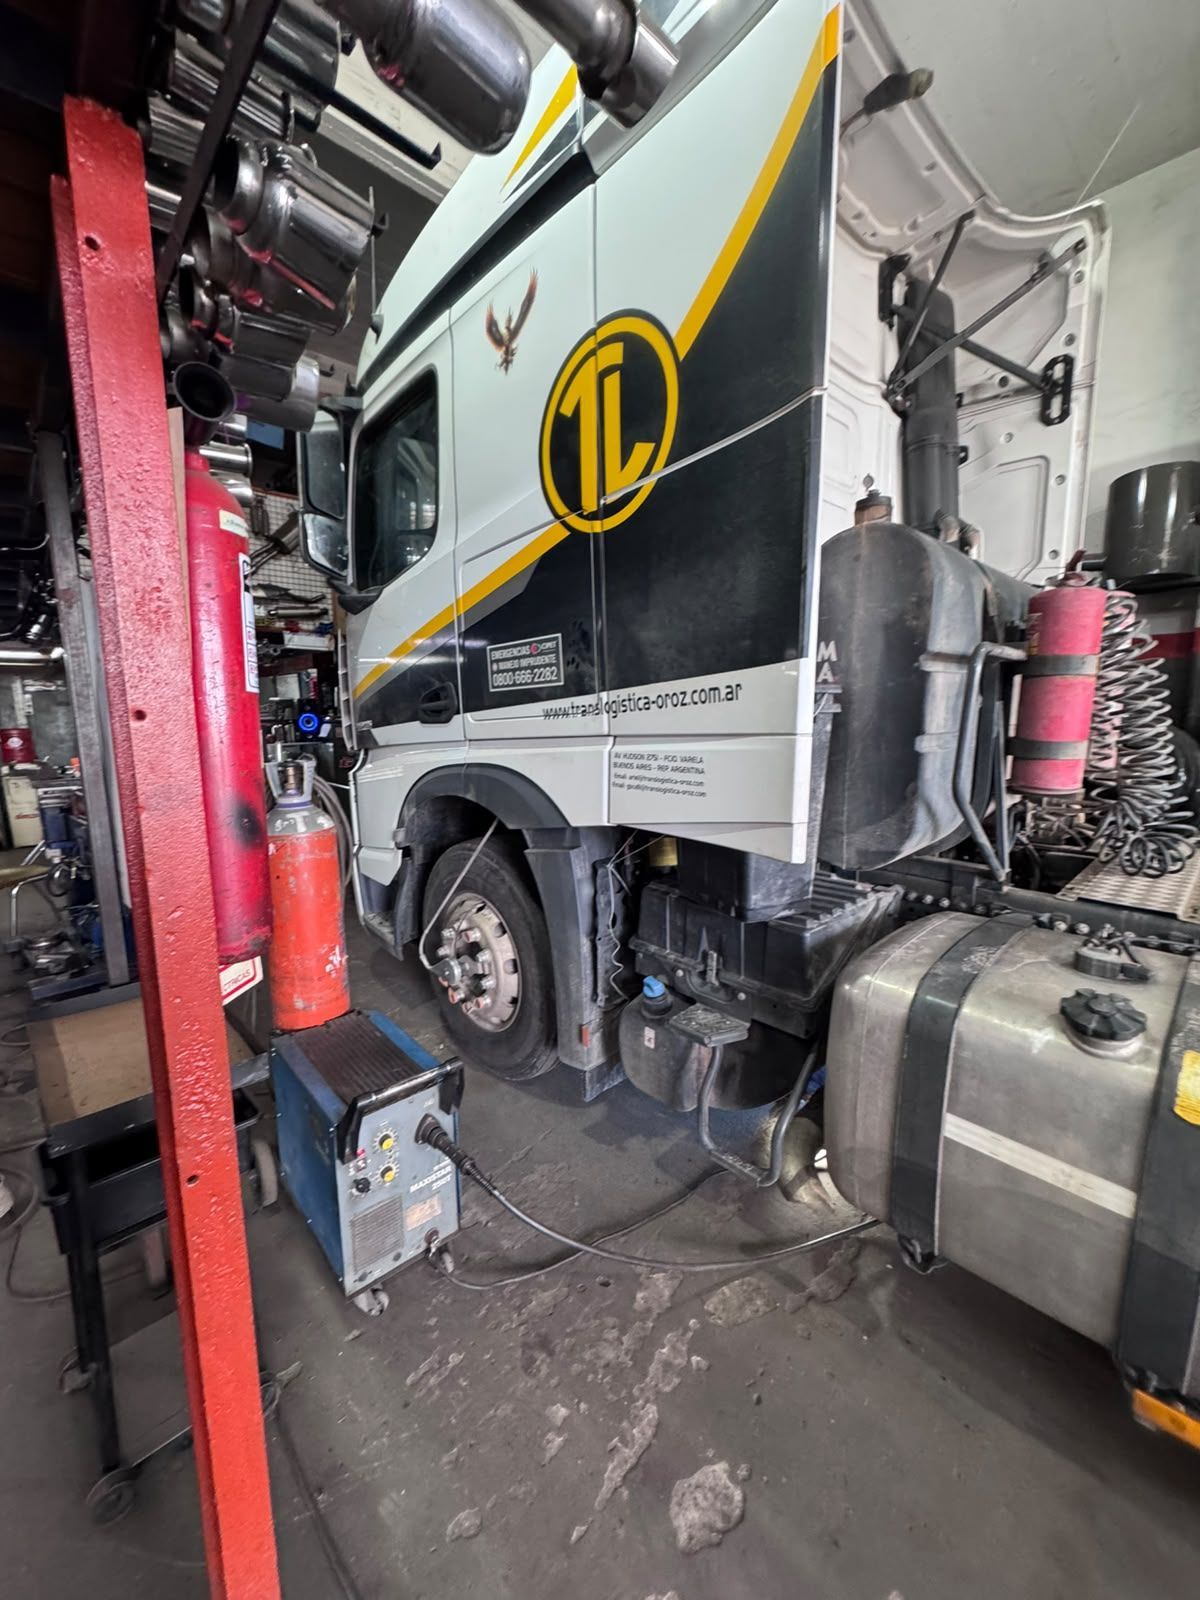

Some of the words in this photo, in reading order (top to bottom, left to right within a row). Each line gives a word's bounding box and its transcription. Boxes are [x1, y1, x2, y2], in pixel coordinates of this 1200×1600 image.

[491, 645, 530, 661] EMERGENCIAS
[520, 653, 557, 667] IMPRUDENTE
[493, 666, 558, 687] 0800-666-2282
[542, 682, 743, 720] www.translogistica-oroz.com.ar
[613, 761, 635, 770] BUENOS
[636, 763, 652, 771] AIRES
[670, 765, 705, 775] ARGENTINA
